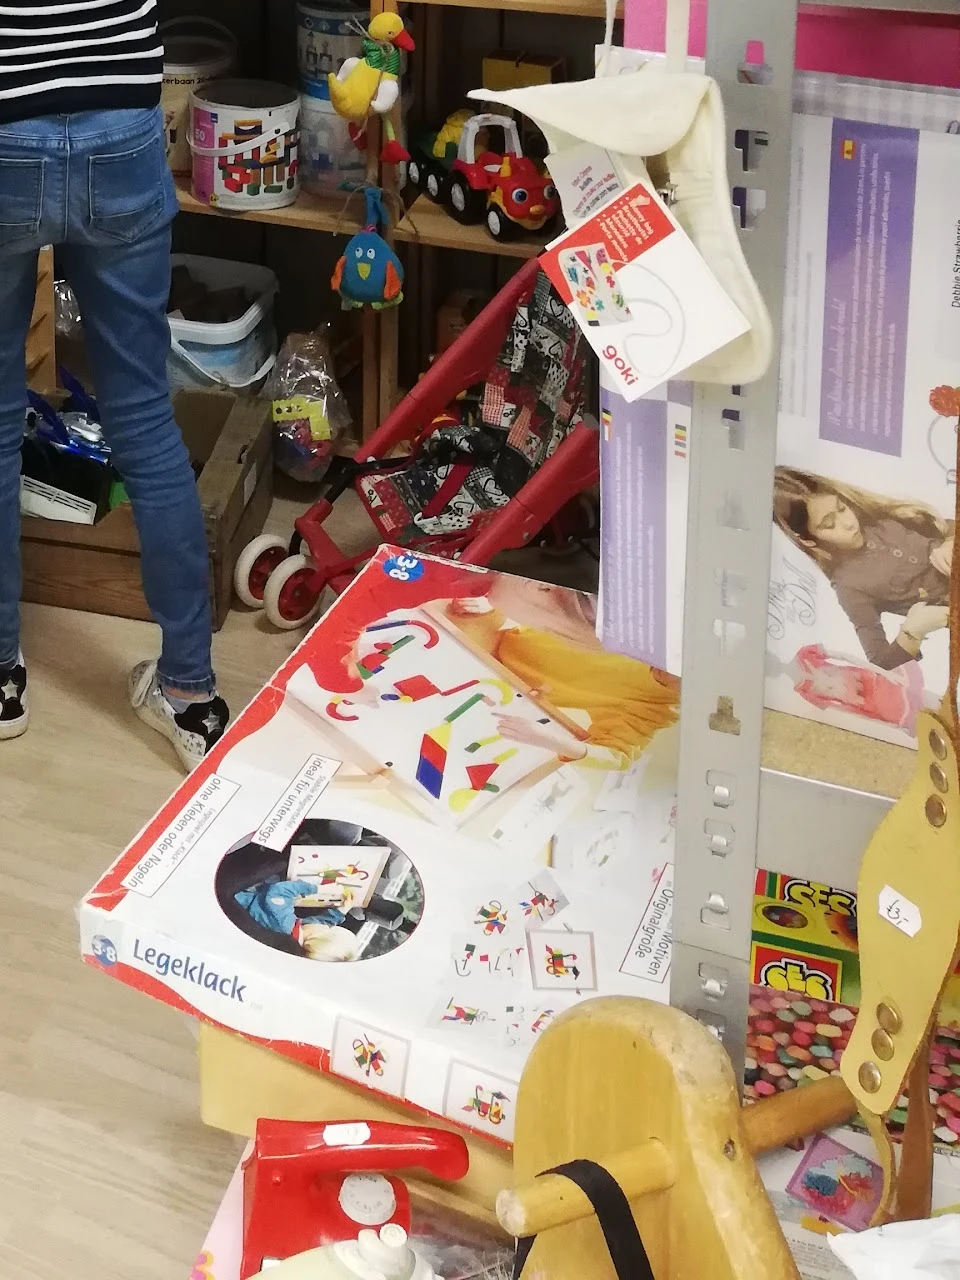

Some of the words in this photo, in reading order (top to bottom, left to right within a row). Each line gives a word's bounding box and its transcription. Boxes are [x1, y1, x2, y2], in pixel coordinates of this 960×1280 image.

[601, 343, 638, 387] goki
[304, 757, 327, 781] ideal
[200, 777, 221, 801] ohne
[176, 800, 206, 833] Kleben
[258, 794, 299, 844] unterwegs
[160, 831, 178, 856] oder
[128, 855, 162, 888] Nageln
[785, 878, 857, 916] SES
[635, 888, 674, 959] Originalgröße
[133, 938, 248, 1003] Legeklack
[763, 960, 831, 1001] SES
